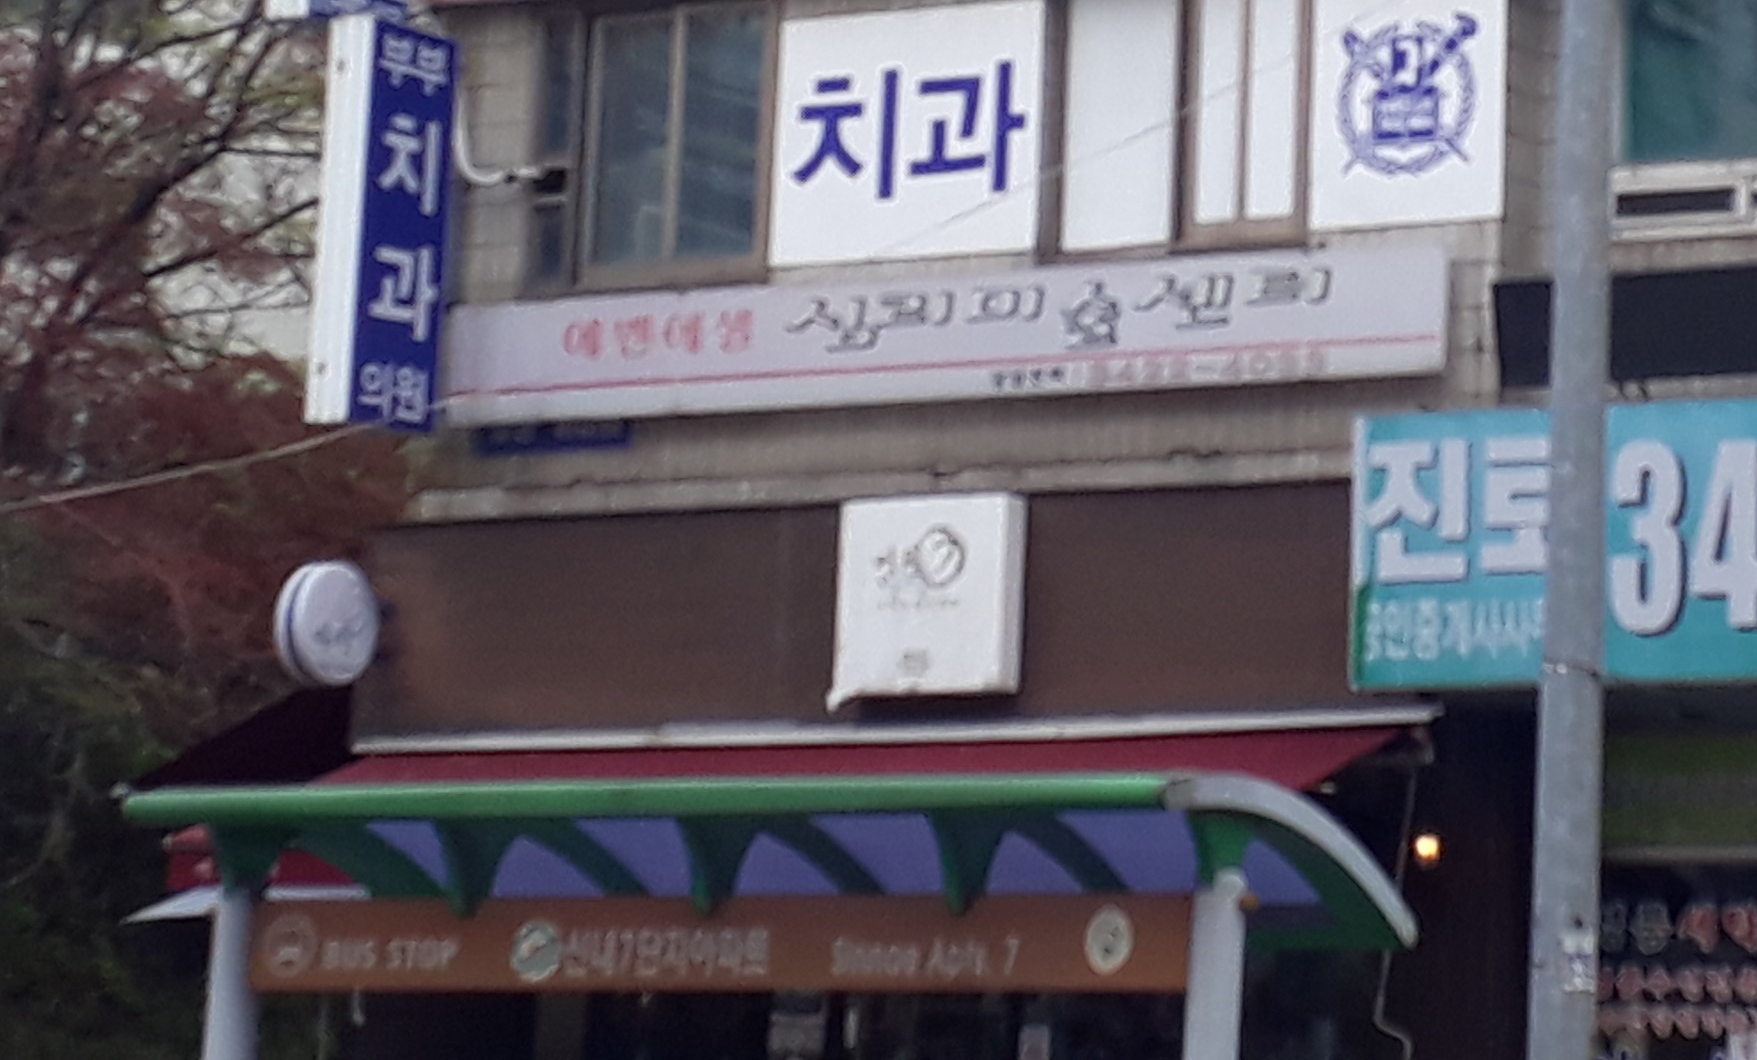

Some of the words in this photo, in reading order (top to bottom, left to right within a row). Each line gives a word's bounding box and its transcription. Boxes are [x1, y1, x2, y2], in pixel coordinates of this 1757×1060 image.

[376, 32, 450, 96] 부부
[791, 60, 1027, 199] 치과
[367, 113, 443, 343] 치과
